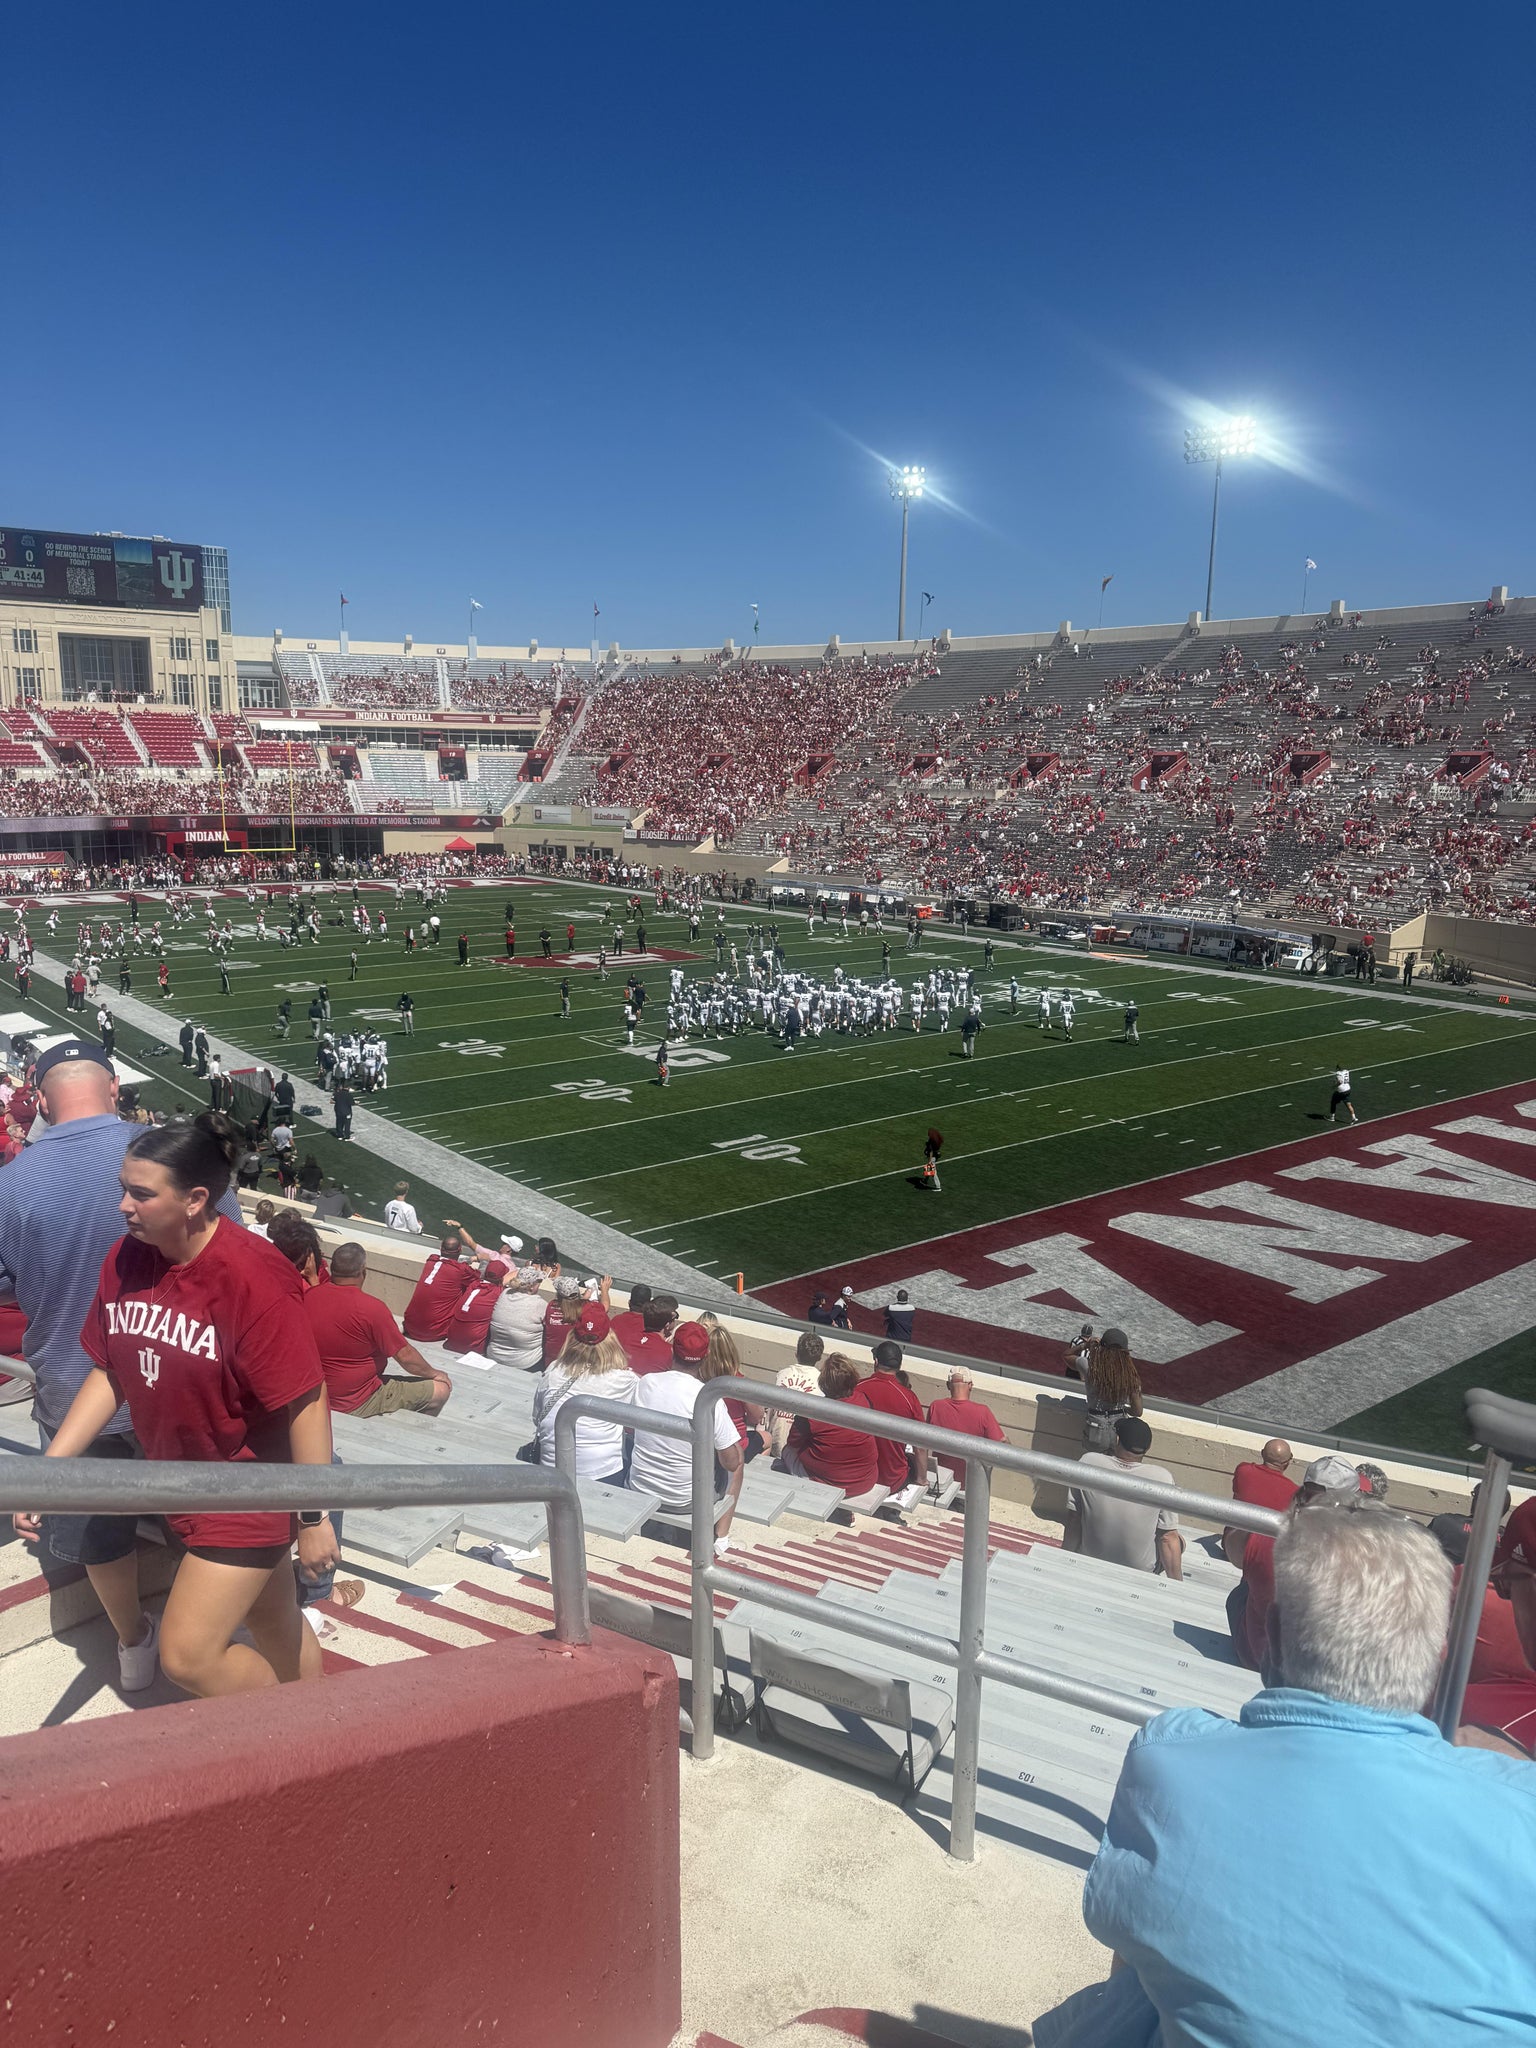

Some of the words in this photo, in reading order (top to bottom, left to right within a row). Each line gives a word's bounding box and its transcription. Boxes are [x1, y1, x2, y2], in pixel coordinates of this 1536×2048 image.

[55, 544, 77, 552] BEHIND
[90, 547, 112, 555] SCENES
[25, 550, 34, 562] 0
[55, 551, 85, 560] MEMORIAL
[86, 553, 112, 561] STADIUM
[14, 569, 42, 582] 41:44
[355, 711, 388, 720] INDIANA
[391, 712, 433, 721] FOOTBALL
[248, 817, 281, 825] WELCOME
[333, 817, 350, 826] BANK
[351, 818, 369, 826] FIELD
[370, 818, 378, 826] AT
[378, 818, 412, 826] MEMORIAL
[413, 818, 441, 826] STADIUM
[185, 831, 230, 842] INDIANA
[640, 830, 670, 840] HOOSIER
[8, 852, 46, 861] FOOTBALL
[438, 1038, 507, 1057] 30
[550, 1078, 633, 1103] 20
[710, 1133, 804, 1163] 10
[391, 1210, 398, 1225] 7
[424, 1261, 443, 1285] 1
[461, 1289, 480, 1312] 1
[105, 1300, 218, 1362] INDIANA
[790, 1629, 803, 1638] 101
[1001, 1644, 1015, 1653] 102
[1177, 1659, 1189, 1668] 103
[932, 1674, 947, 1685] 102
[1090, 1724, 1105, 1735] 103
[1018, 1771, 1036, 1784] 103
